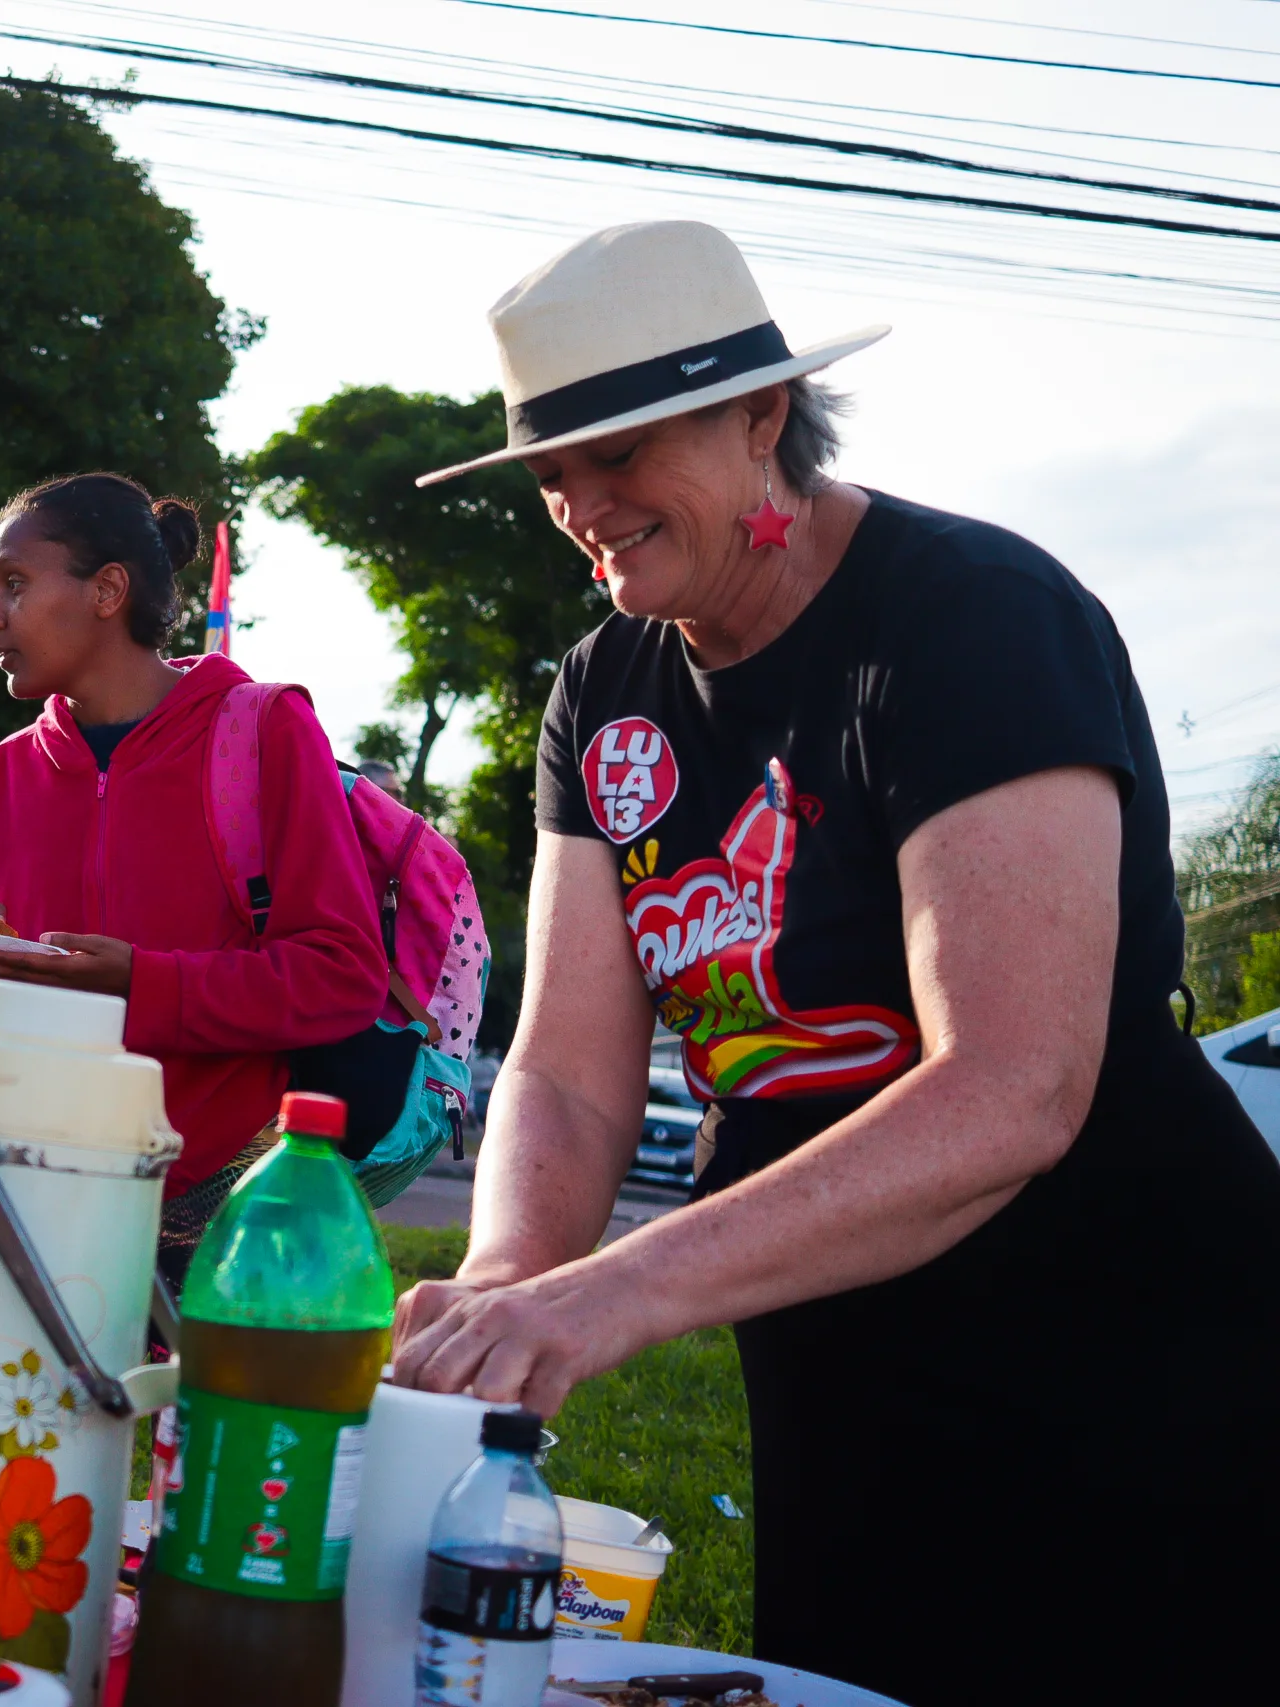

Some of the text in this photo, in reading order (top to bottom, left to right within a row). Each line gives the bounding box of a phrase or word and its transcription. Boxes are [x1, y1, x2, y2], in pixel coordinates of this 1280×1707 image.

[600, 728, 662, 766] LU
[597, 763, 655, 801] LA
[603, 797, 644, 833] 13
[558, 1596, 626, 1623] Claybom
